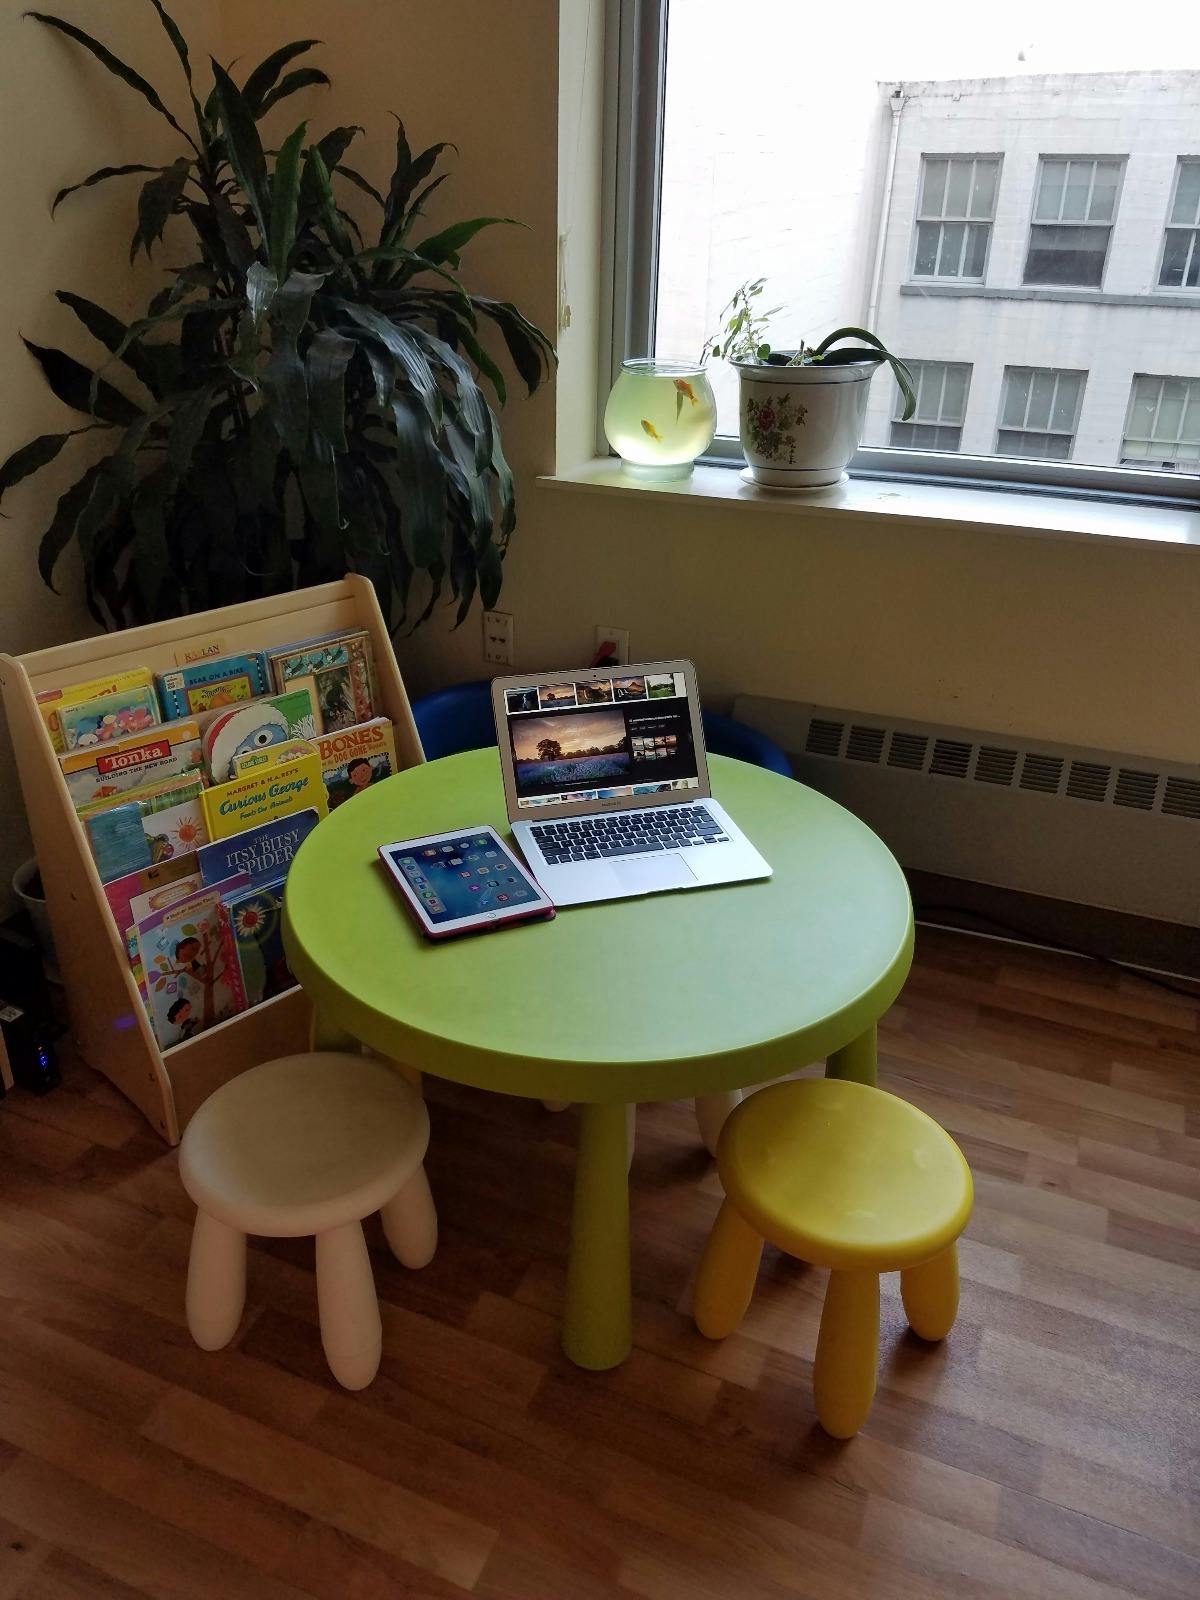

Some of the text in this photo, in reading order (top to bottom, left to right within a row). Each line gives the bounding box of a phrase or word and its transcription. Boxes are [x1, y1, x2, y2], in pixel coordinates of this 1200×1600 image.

[189, 677, 207, 686] BEAR
[229, 667, 244, 676] BIKE
[319, 726, 384, 761] BONES
[334, 751, 348, 764] DOG
[349, 744, 368, 758] GONE
[96, 770, 128, 783] BUILDING
[129, 765, 142, 774] THE
[159, 757, 178, 766] ROAD
[105, 747, 163, 769] Tonka
[226, 781, 259, 797] MARGRET
[281, 768, 299, 778] REY'S
[219, 777, 309, 816] Curious George
[240, 809, 257, 820] Feeds
[257, 804, 268, 813] the
[226, 829, 300, 868] ITSY BITSY
[253, 834, 269, 844] THE
[237, 845, 296, 875] SPIDER
